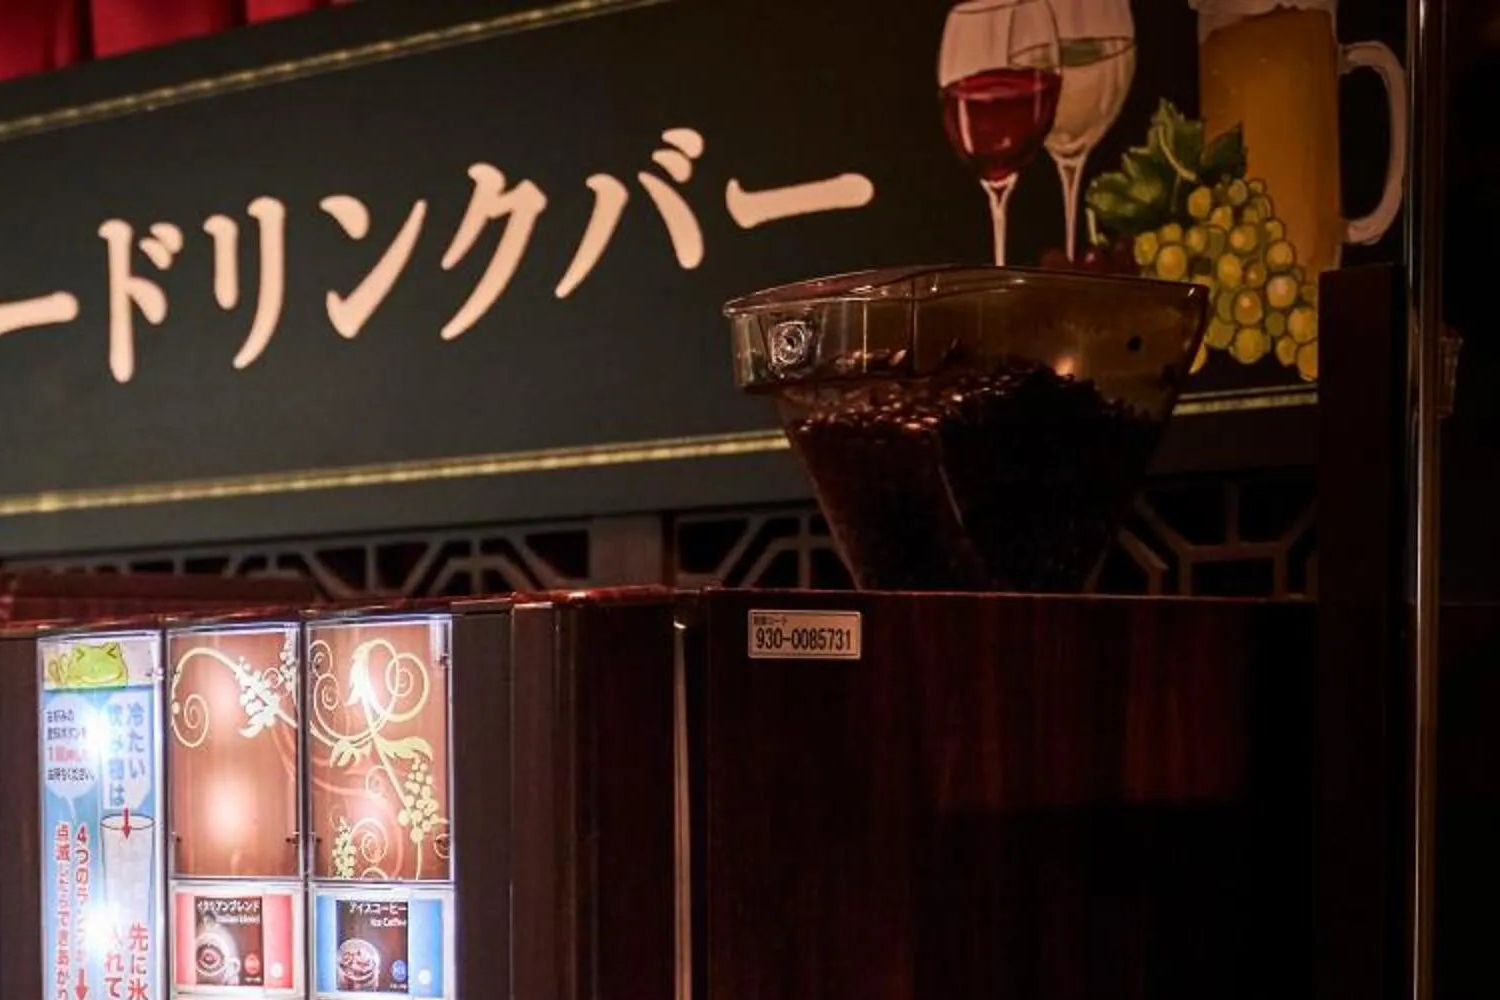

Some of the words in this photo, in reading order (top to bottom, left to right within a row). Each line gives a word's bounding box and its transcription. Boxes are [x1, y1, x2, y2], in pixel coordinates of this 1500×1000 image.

[756, 627, 851, 650] 930-0085731
[349, 903, 408, 916] アイスコーヒー
